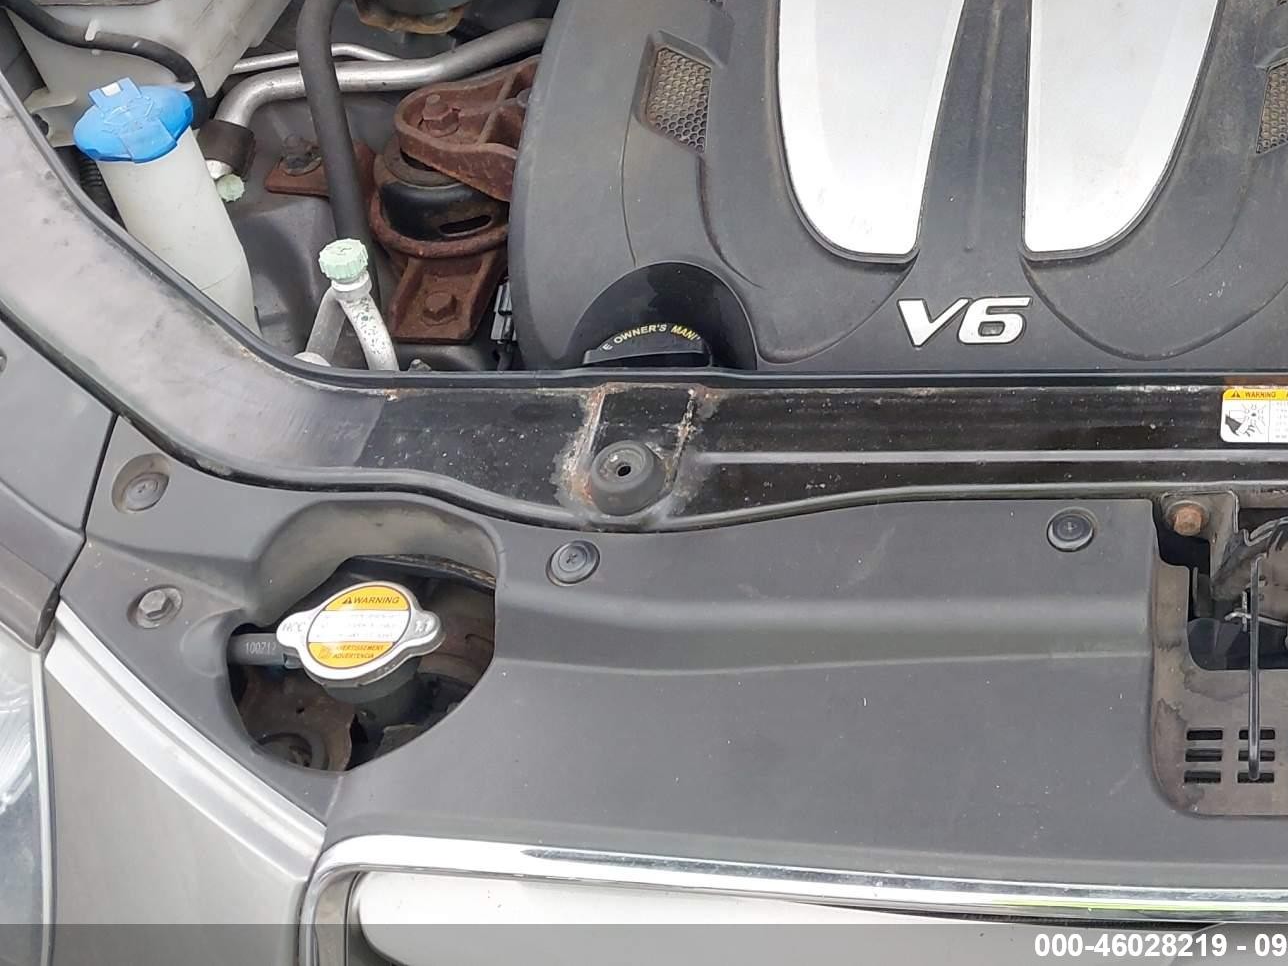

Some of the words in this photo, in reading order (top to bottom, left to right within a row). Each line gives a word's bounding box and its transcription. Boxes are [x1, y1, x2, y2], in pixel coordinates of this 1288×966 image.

[897, 296, 1033, 348] V6
[614, 324, 667, 344] OWNER'S
[352, 596, 400, 605] WARNING
